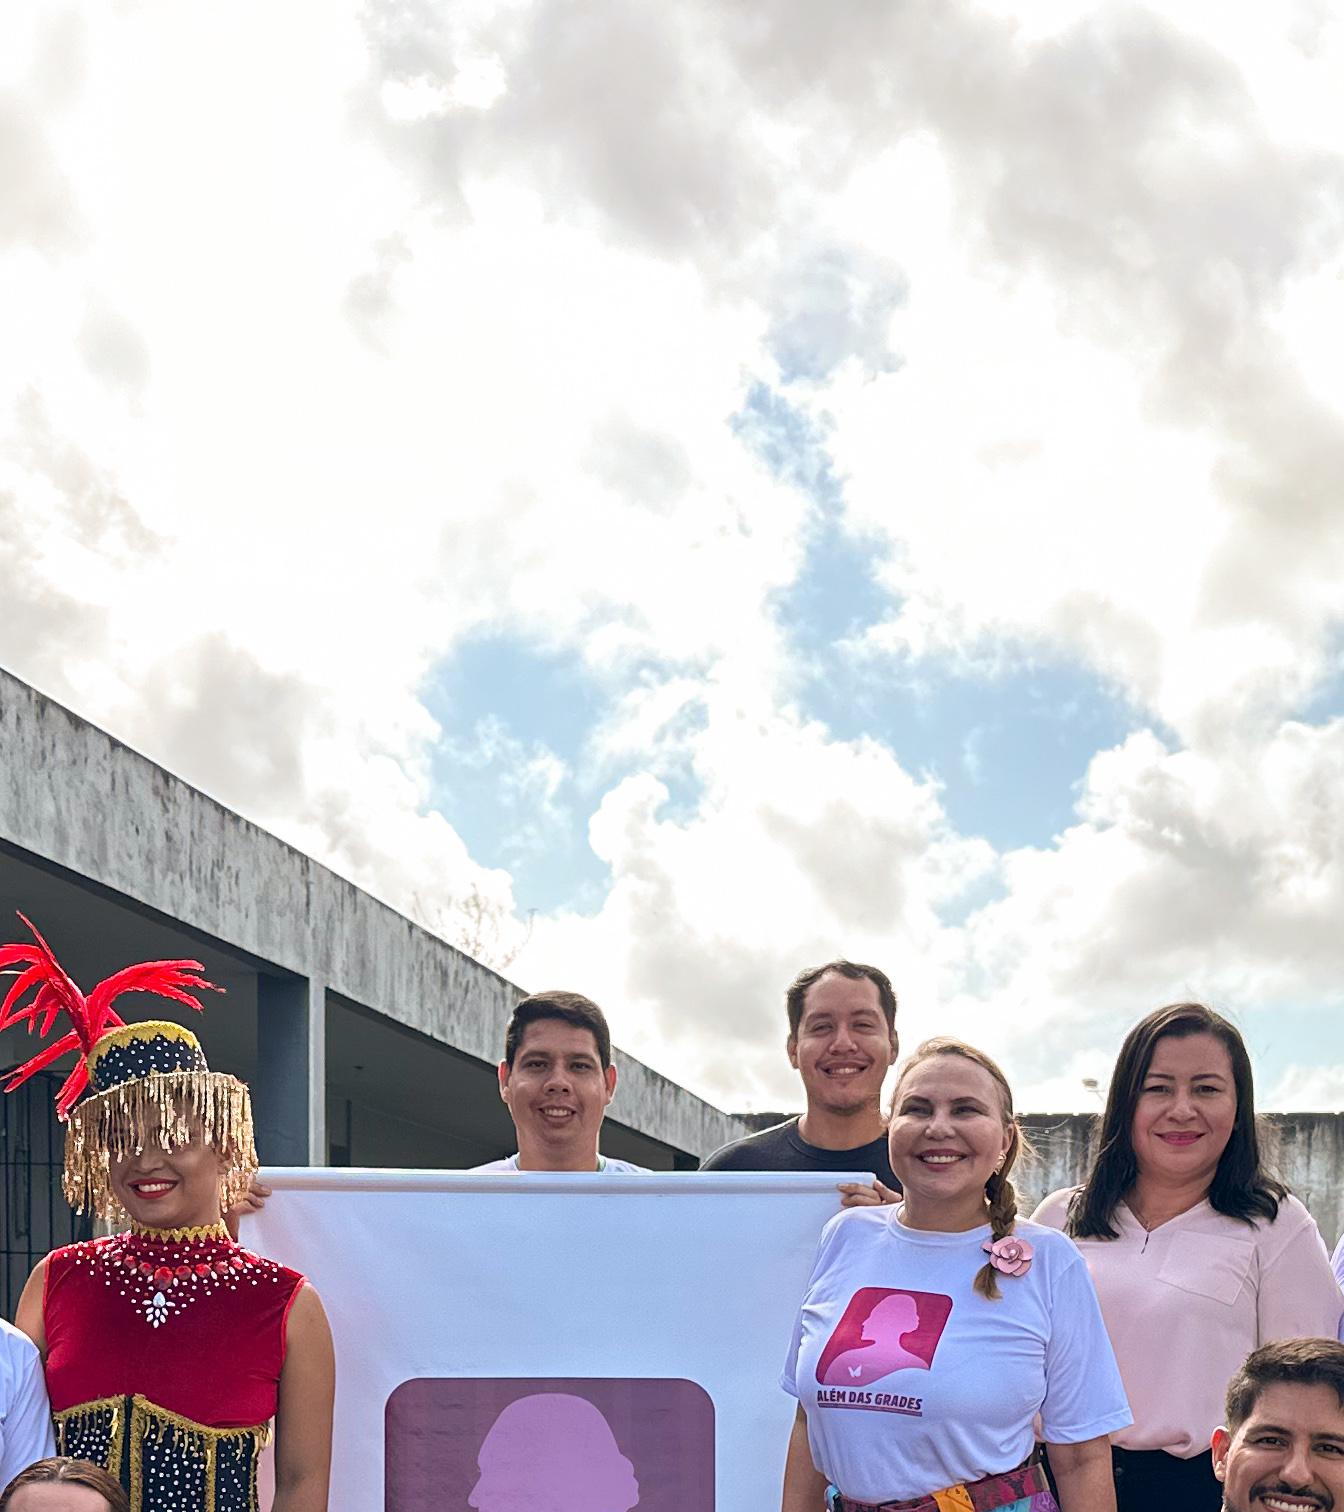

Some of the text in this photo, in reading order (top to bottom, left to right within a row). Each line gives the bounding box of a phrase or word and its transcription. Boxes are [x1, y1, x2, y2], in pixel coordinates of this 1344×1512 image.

[817, 1387, 846, 1403] ALÉM
[848, 1390, 873, 1404] DAS
[874, 1393, 923, 1410] GRADES
